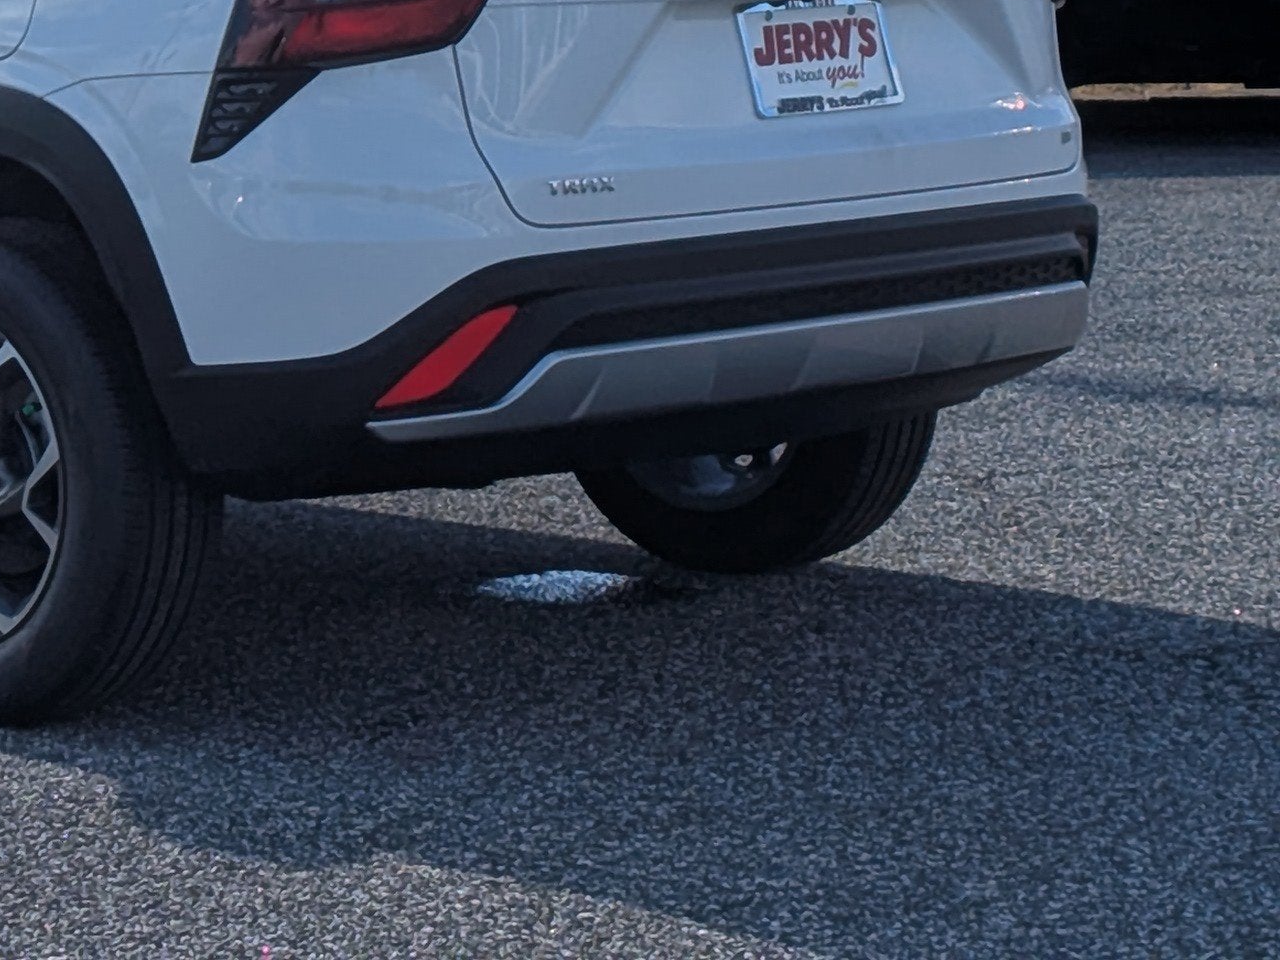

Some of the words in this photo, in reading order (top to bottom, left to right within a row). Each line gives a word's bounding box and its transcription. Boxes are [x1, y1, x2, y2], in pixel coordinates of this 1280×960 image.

[754, 18, 877, 66] JERRY'S
[777, 70, 793, 85] It's
[794, 68, 824, 83] About
[548, 177, 614, 196] TRAX
